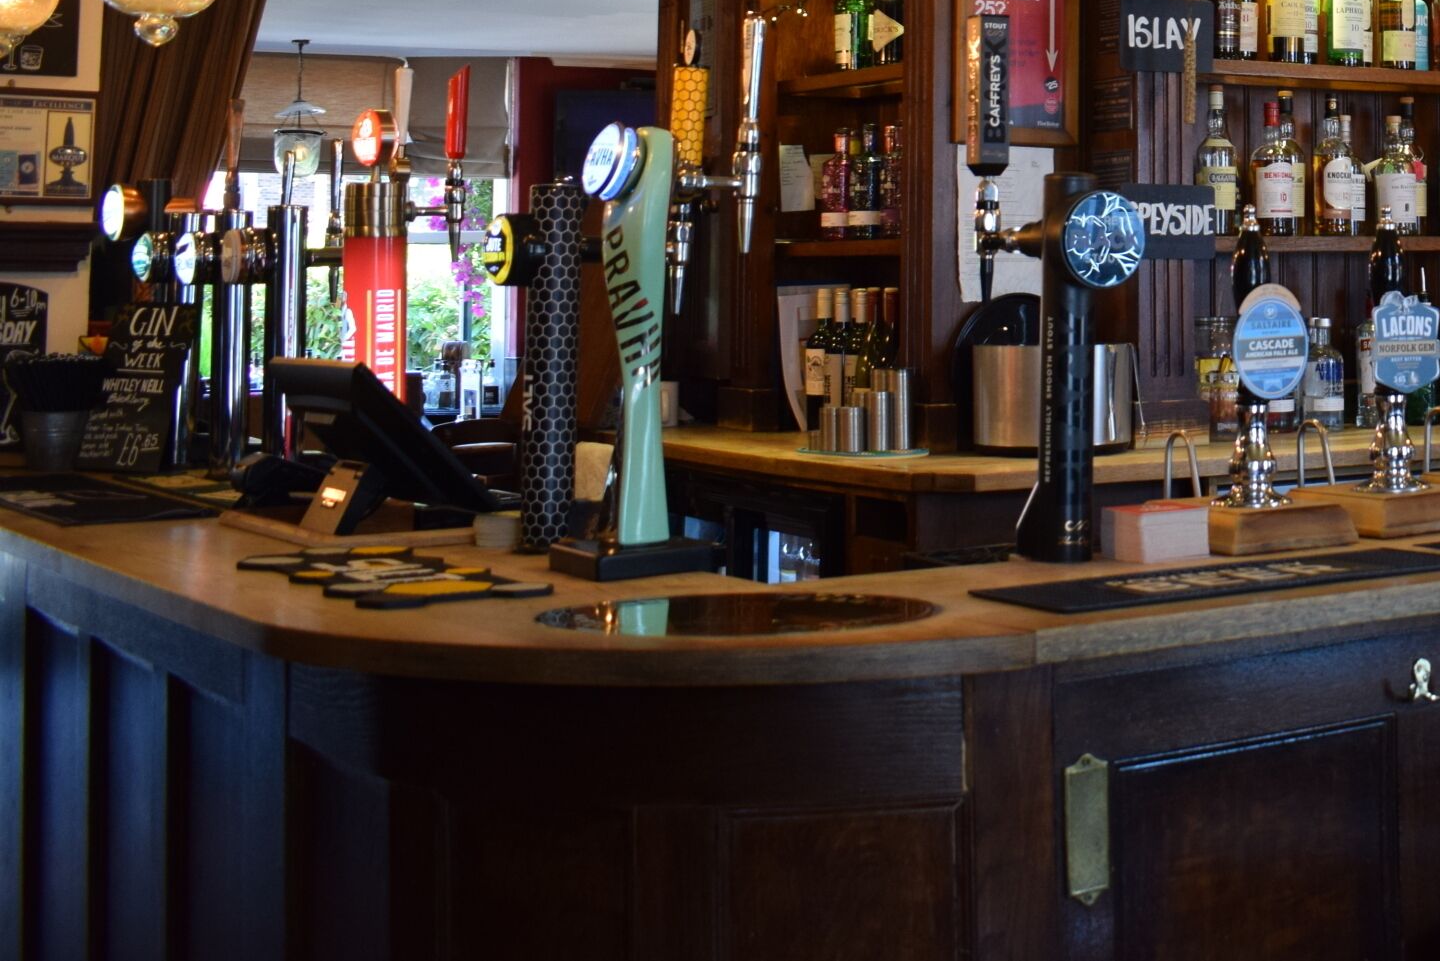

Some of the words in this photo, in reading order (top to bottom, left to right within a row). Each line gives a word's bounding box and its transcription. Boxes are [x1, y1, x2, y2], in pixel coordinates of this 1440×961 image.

[975, 0, 1007, 16] 25?
[984, 22, 1008, 30] STOUT
[1127, 13, 1202, 51] ISLAY
[1351, 23, 1360, 32] 10
[989, 54, 1001, 128] CAFFREY'S
[1280, 192, 1288, 202] 10
[129, 305, 180, 337] GIN
[376, 289, 395, 342] MADRID
[1251, 320, 1292, 330] SALTAIRE
[1381, 315, 1433, 338] LACONS
[1248, 339, 1295, 351] CASCADE
[1379, 343, 1418, 353] NORFOLK
[1418, 342, 1435, 352] GEM
[124, 353, 164, 369] WEEK
[376, 347, 395, 366] DE
[1245, 351, 1273, 359] AMERICAN
[102, 377, 141, 393] WHITLEY
[140, 378, 164, 393] NEILL
